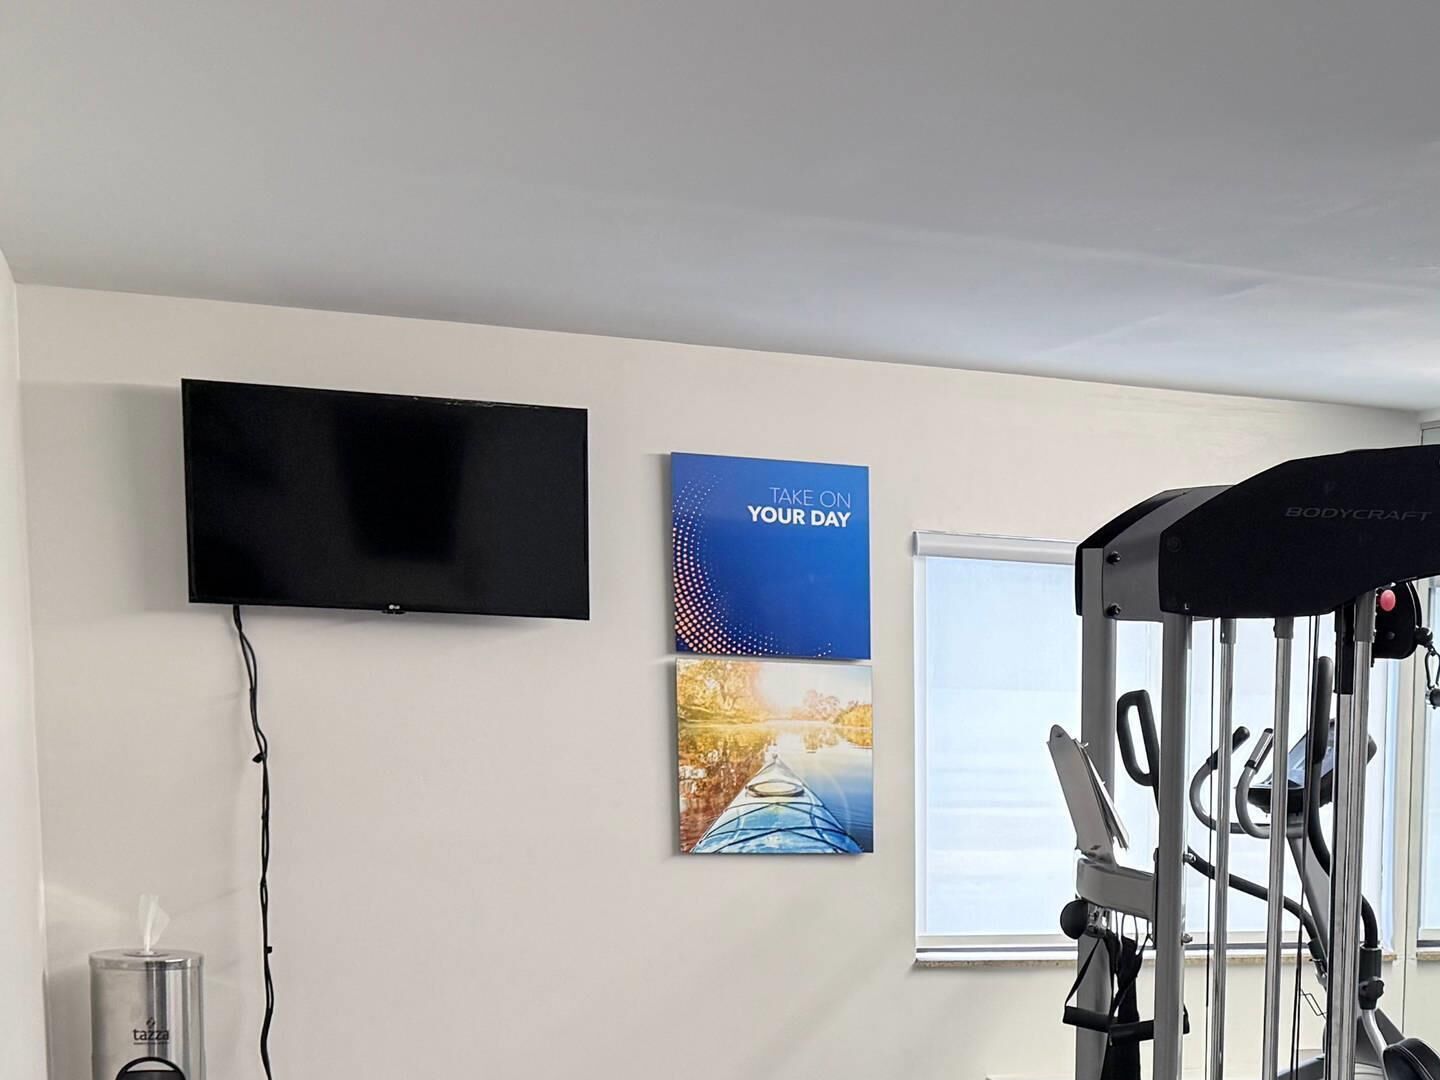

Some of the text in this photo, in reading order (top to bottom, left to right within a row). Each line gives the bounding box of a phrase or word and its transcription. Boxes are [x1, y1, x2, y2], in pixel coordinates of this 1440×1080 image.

[769, 487, 851, 508] TAKE ON
[747, 505, 851, 528] YOUR DAY
[1285, 506, 1433, 521] BODYCRAFT
[132, 1028, 170, 1041] tazza
